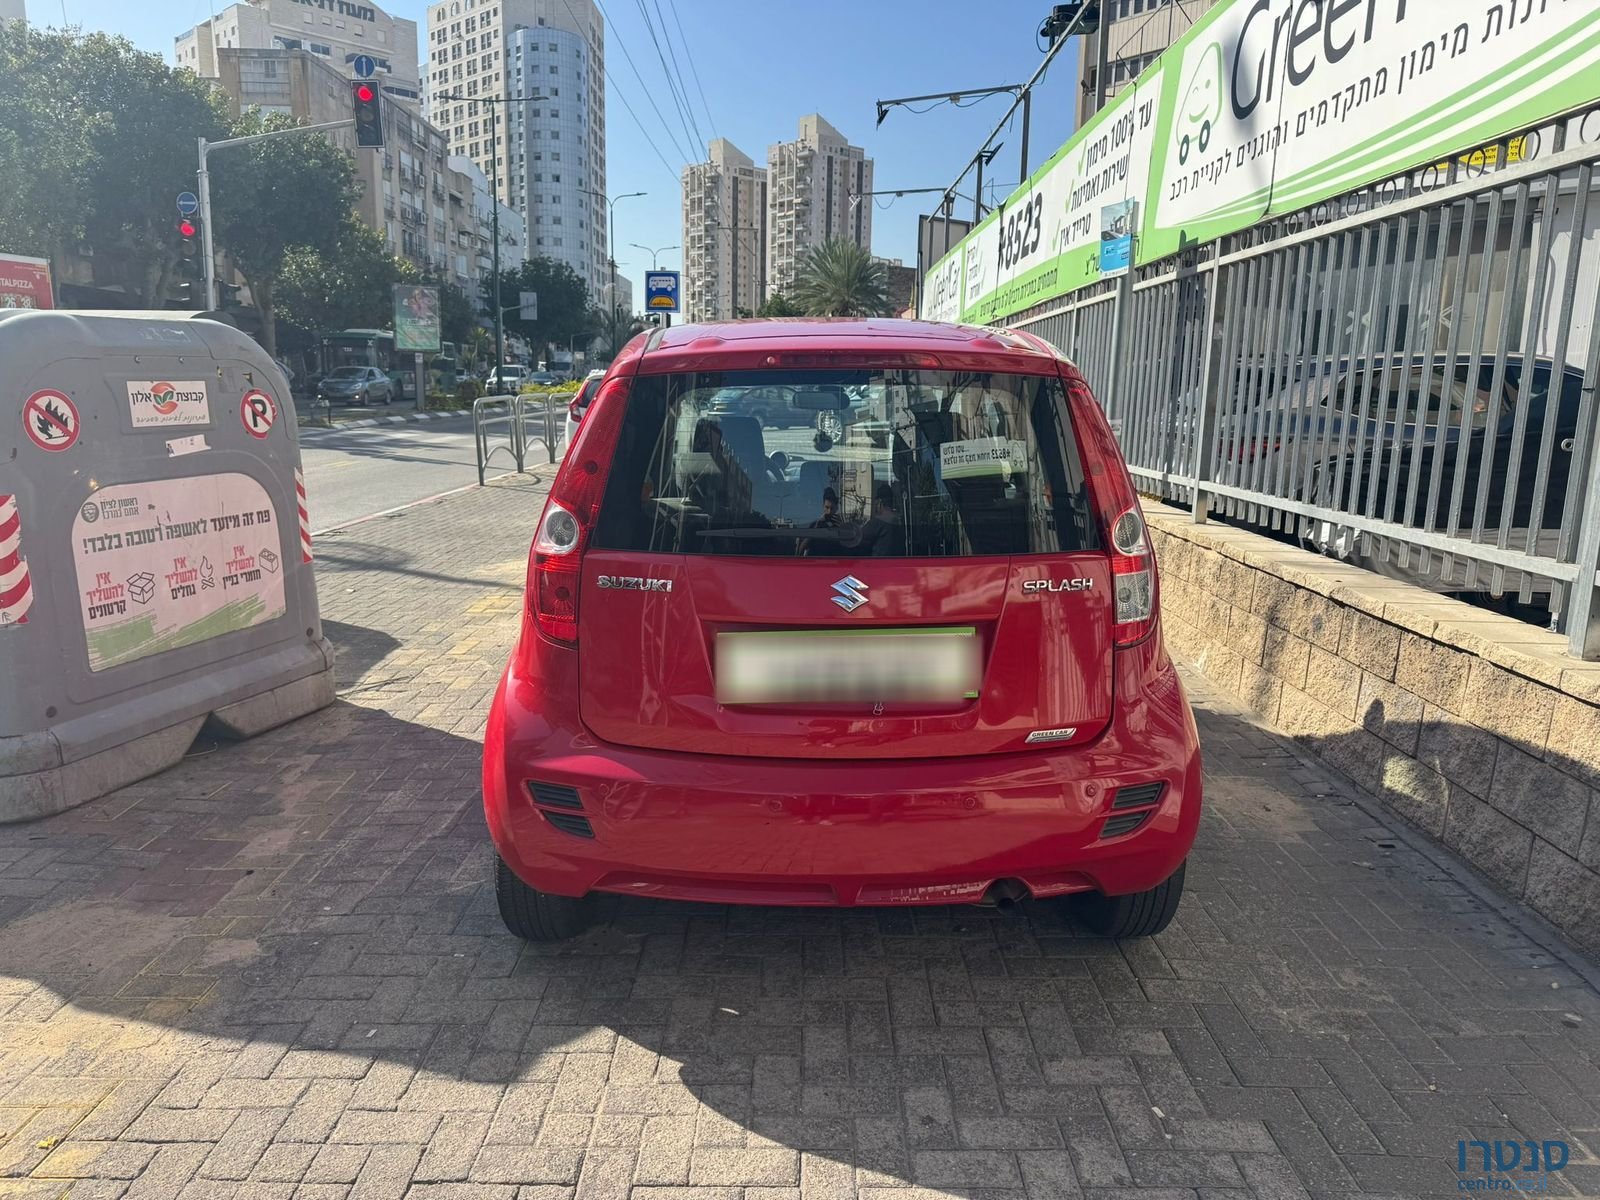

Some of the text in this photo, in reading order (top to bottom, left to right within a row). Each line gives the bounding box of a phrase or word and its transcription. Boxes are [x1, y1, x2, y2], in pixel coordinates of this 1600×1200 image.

[1398, 23, 1469, 94] מימון
[1296, 67, 1388, 137] מתקדמים
[1139, 98, 1153, 130] עד
[1236, 121, 1288, 168] והוגנים
[1086, 134, 1108, 177] מימון
[1191, 149, 1231, 190] לקניית
[1071, 154, 1130, 213] שירות ואמינות
[1169, 176, 1188, 201] רכב
[1073, 212, 1091, 242] טרייד
[131, 390, 204, 406] קבוצת אלון
[119, 497, 138, 509] ראשון
[210, 514, 241, 532] מיועד
[242, 512, 254, 527] זה
[256, 510, 271, 524] פח
[166, 518, 207, 540] לאשפה
[83, 533, 123, 554] בלבד!
[233, 545, 245, 557] אין
[173, 556, 187, 571] אין
[225, 556, 255, 572] להשליך
[96, 571, 111, 586] אין
[165, 568, 198, 588] להשליך
[222, 569, 262, 589] חומרי בניין
[597, 575, 672, 593] SUZUKI
[1023, 578, 1094, 595] SPLASH
[86, 583, 125, 605] להשליך
[171, 584, 196, 600] גחלים
[88, 600, 127, 620] קרטונים
